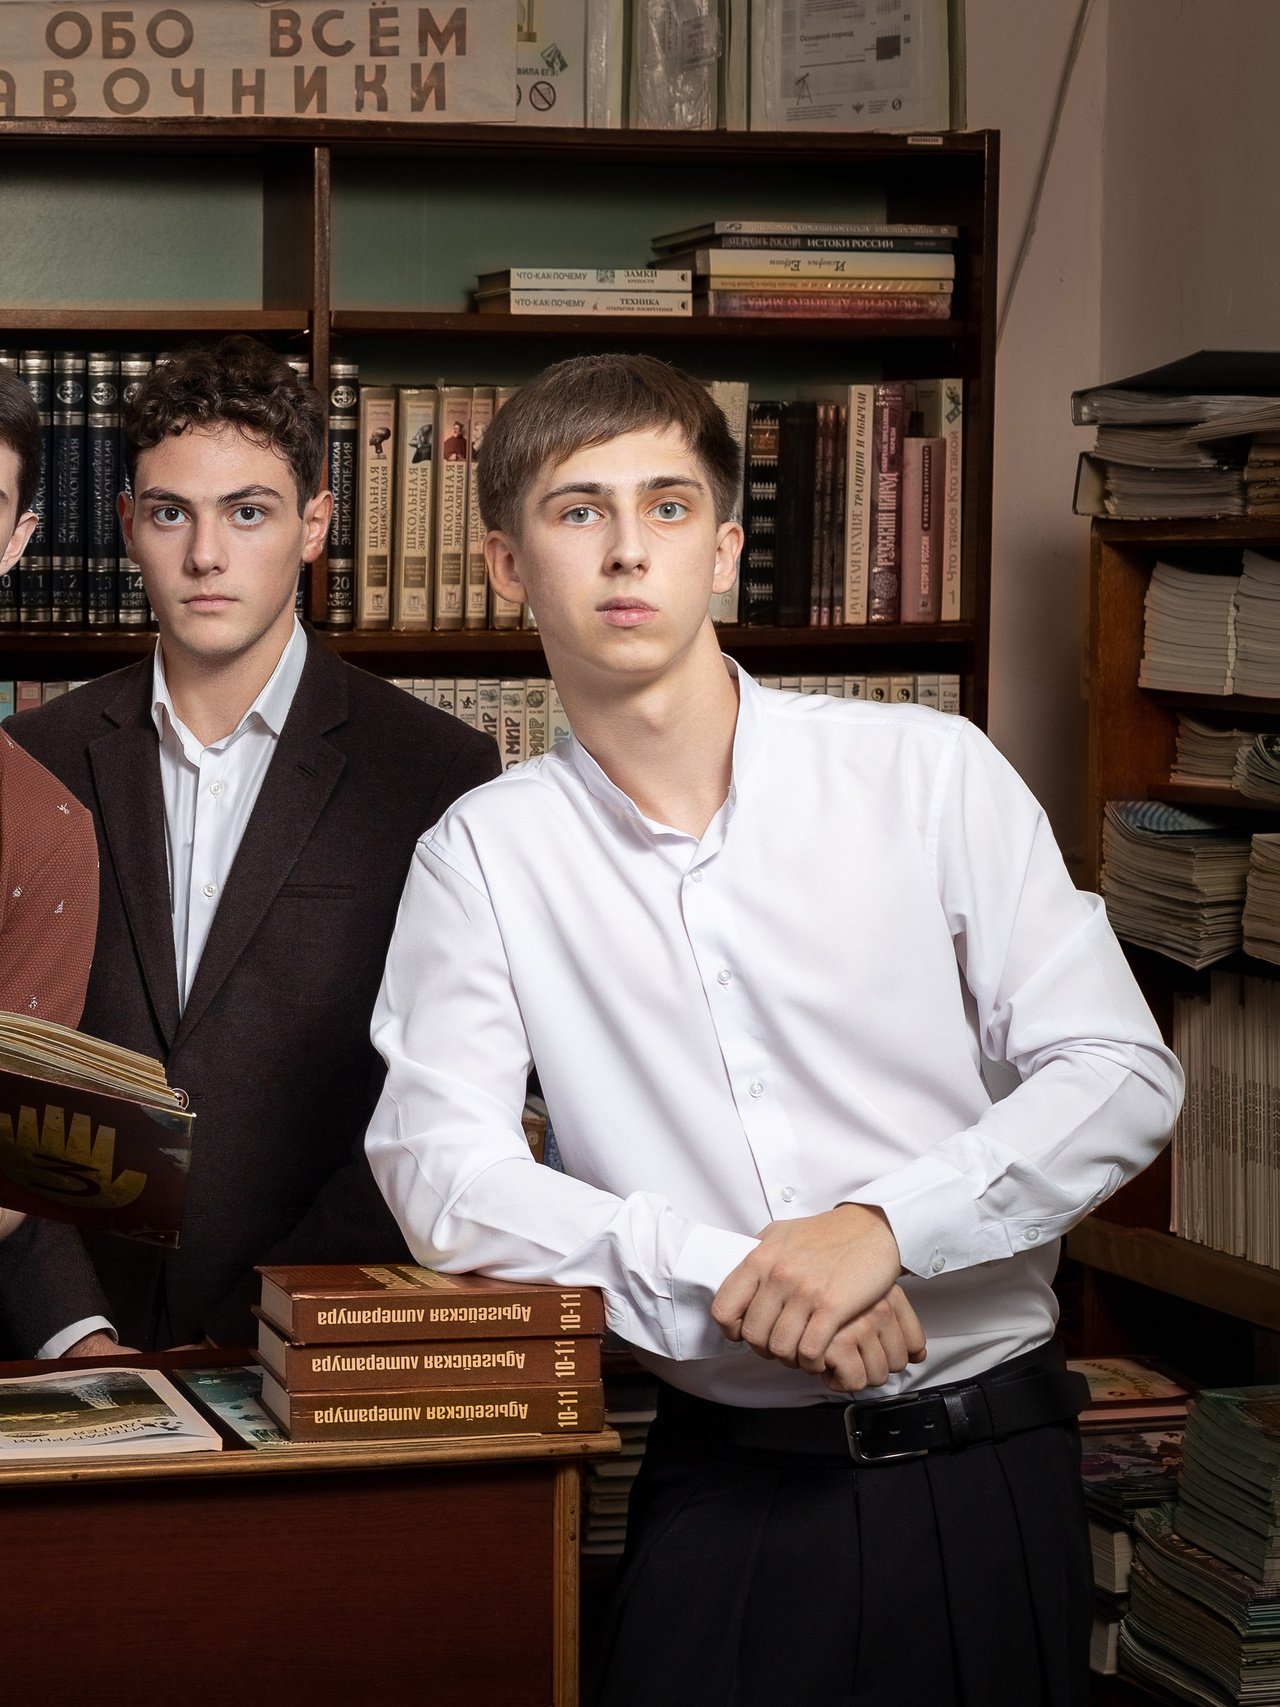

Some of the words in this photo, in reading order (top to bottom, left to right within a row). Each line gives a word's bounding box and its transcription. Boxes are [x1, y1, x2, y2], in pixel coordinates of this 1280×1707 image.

[45, 9, 193, 59] ОБО
[269, 1, 467, 58] ВСЁМ
[807, 239, 850, 248] ИСТОКИ
[851, 239, 893, 248] РОССИИ
[624, 270, 658, 278] ЗАМКИ
[807, 259, 846, 271] История
[619, 298, 660, 306] ТЕХНИКА
[947, 430, 959, 474] такой
[70, 438, 79, 544] ЭНЦИКЛОПЕДИЯ
[104, 440, 113, 544] ЭНЦИКЛОПЕДИЯ
[341, 442, 352, 546] ЭНЦИКЛОПЕДИЯ
[852, 451, 866, 507] ТРАДИЦИИ
[876, 470, 899, 510] НАРОД
[947, 476, 958, 503] Кто
[369, 466, 379, 549] ШКОЛЬНАЯ
[407, 468, 417, 550] ШКОЛЬНАЯ
[418, 468, 427, 550] ЭНЦИКЛОПЕДИЯ
[443, 464, 453, 546] ШКОЛЬНАЯ
[454, 464, 463, 546] ЭНЦИКЛОПЕДИЯ
[873, 511, 898, 566] РУССКИЙ
[948, 507, 958, 550] такое
[921, 535, 930, 563] РОССИИ
[947, 552, 958, 582] Что
[27, 574, 43, 588] 11
[60, 574, 77, 588] 12
[126, 576, 144, 590] 14
[332, 576, 350, 590] 20
[848, 557, 864, 615] РУССКАЯ
[921, 564, 930, 595] ИСТОРИЯ
[505, 716, 521, 755] МИР
[529, 717, 545, 758] МИР
[317, 1307, 425, 1326] литература
[429, 1303, 532, 1323] Адыгейская
[560, 1293, 581, 1331] 10-11
[311, 1355, 419, 1372] литература
[423, 1351, 526, 1371] Адыгейская
[554, 1340, 576, 1378] 10-11
[314, 1406, 422, 1425] литература
[426, 1402, 529, 1422] Адыгейская
[557, 1390, 579, 1428] 10-11
